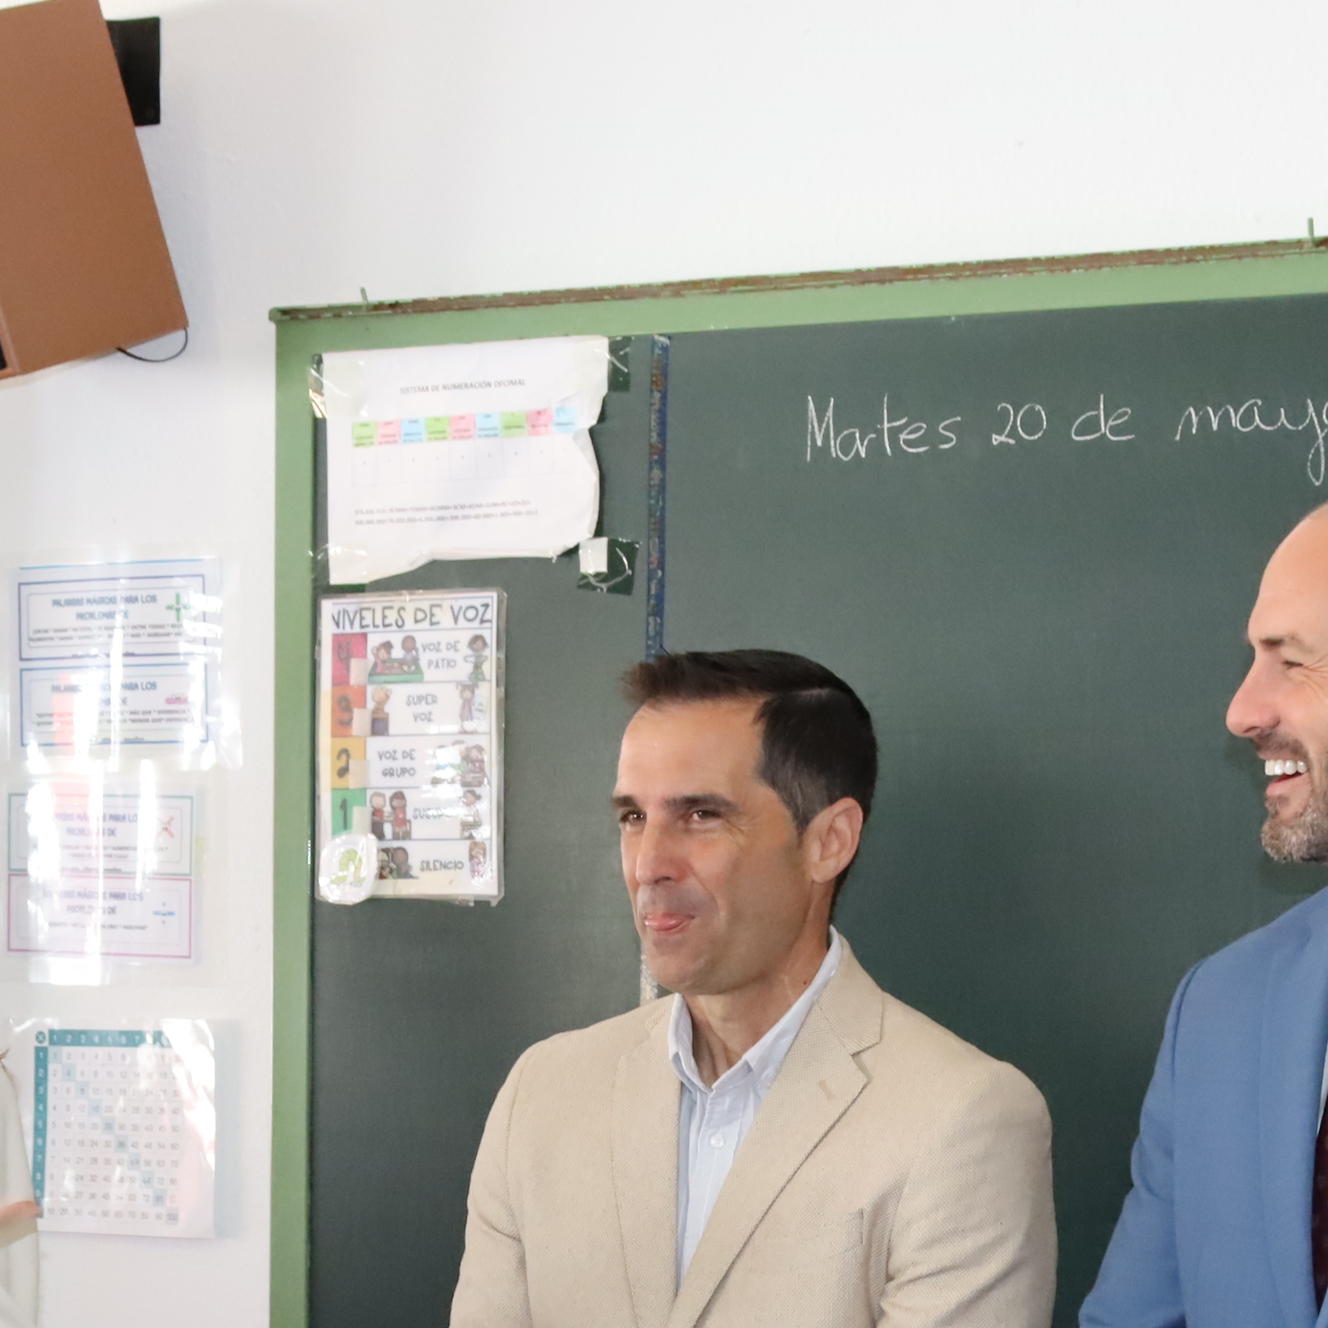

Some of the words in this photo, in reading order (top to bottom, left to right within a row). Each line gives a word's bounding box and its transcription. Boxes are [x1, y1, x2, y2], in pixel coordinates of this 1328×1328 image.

[806, 392, 962, 462] Martes
[992, 402, 1047, 446] 20
[1071, 393, 1136, 442] de
[332, 605, 406, 630] NIVELES
[414, 603, 442, 626] DE
[450, 602, 493, 626] VOZ
[421, 642, 442, 653] VOZ
[446, 640, 461, 652] DE
[427, 658, 457, 670] PATIO
[406, 693, 438, 707] SUPER
[413, 711, 434, 723] VOZ
[377, 749, 398, 761] VOZ
[402, 749, 416, 760] DE
[381, 767, 416, 778] GRUPO
[420, 859, 464, 872] SILENCIO
